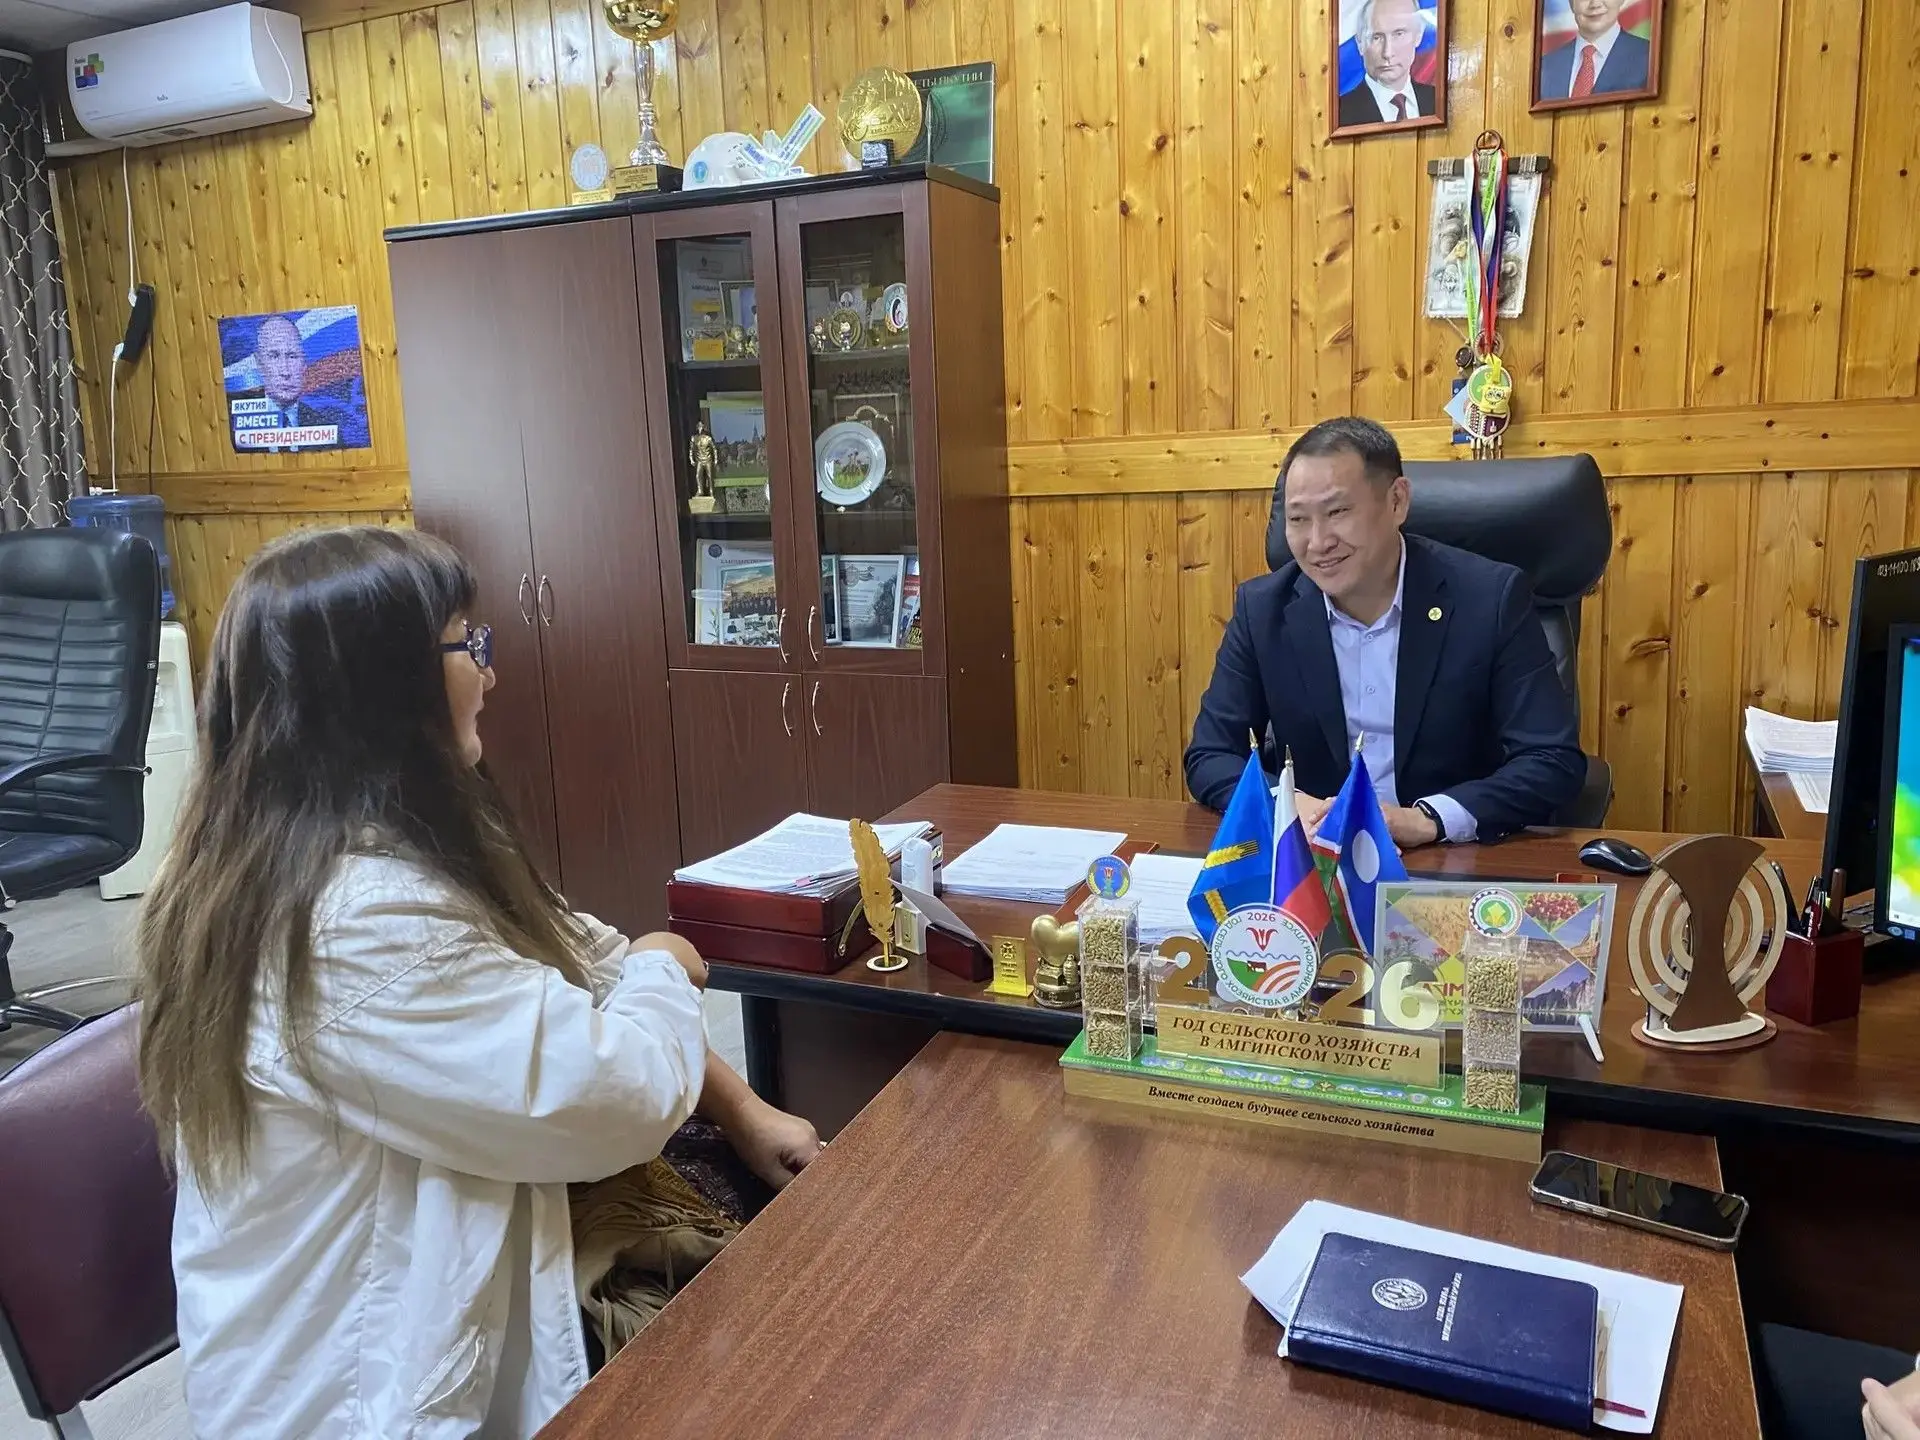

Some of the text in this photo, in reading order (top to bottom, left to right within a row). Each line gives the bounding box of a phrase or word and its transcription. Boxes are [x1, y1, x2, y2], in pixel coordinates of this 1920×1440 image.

[234, 401, 267, 411] ЯКУТИЯ
[236, 414, 279, 427] ВМЕСТЕ
[239, 428, 335, 445] С ПРЕЗИДЕНТОМ!
[1247, 911, 1276, 921] 2026
[1281, 918, 1308, 945] УЛУСЕ
[1290, 945, 1314, 1000] АМГИНСКОМ
[1226, 980, 1281, 1006] ХОЗЯЙСТВА
[1282, 995, 1289, 1004] В
[1173, 1016, 1421, 1059] ГОД СЕЛЬСКОГО ХОЗЯЙСТВА
[1200, 1035, 1393, 1071] В АМГИНСКОМ УЛУСЕ
[1148, 1086, 1435, 1137] Вместе создаем будущее сельского хозяйства
